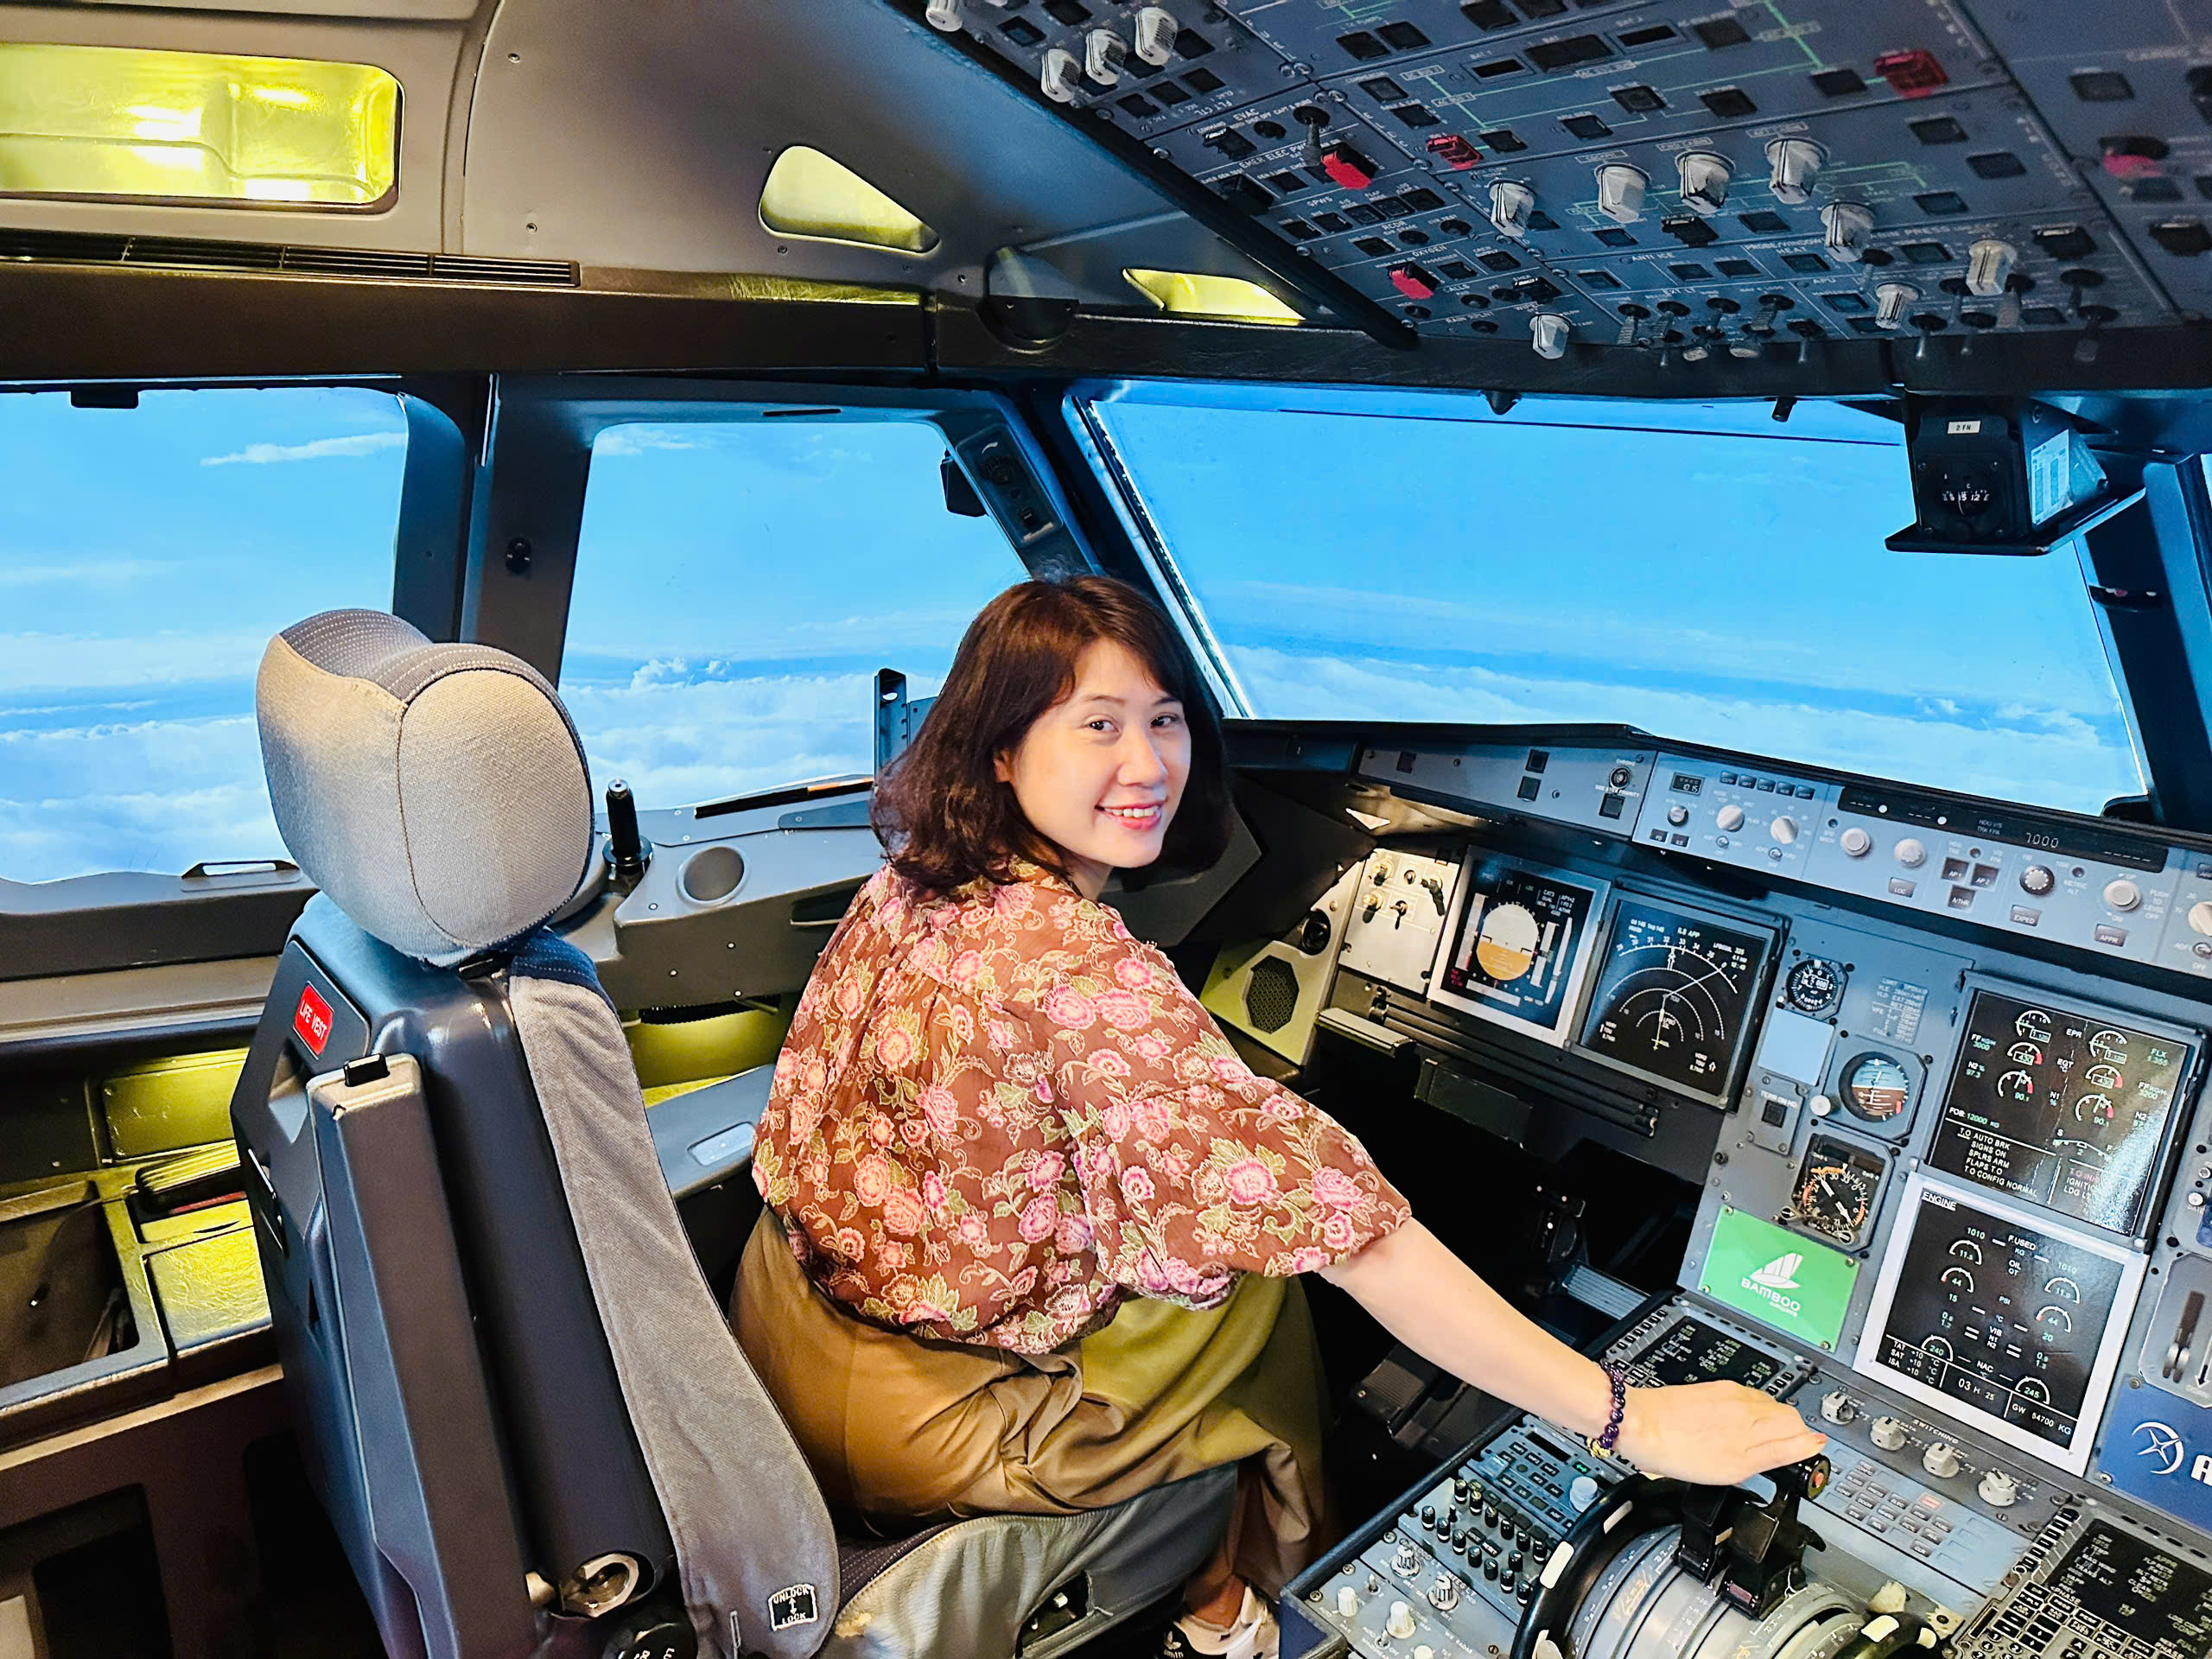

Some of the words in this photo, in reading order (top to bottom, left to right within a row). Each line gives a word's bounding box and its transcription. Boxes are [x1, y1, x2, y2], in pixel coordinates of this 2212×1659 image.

[1233, 108, 1259, 122] EVAC
[1239, 156, 1266, 168] EMER
[1267, 149, 1289, 162] ELEC
[1306, 196, 1333, 207] GPWS
[1412, 245, 1447, 257] OXYGEN
[1776, 246, 1808, 255] HEAT
[1989, 827, 2000, 836] FPA
[2025, 832, 2059, 849] 7000
[1894, 887, 1907, 895] LOC
[2150, 889, 2170, 899] PUSH
[1952, 897, 1970, 906] A/THR
[2013, 914, 2036, 925] EXPED
[1688, 929, 1700, 938] APP
[2100, 934, 2120, 944] APPR
[299, 999, 313, 1024] LIFE
[311, 1013, 327, 1040] VEST
[2066, 1028, 2082, 1038] EPR
[1973, 1041, 1990, 1051] 3000
[2151, 1047, 2168, 1058] FLX
[1967, 1061, 1978, 1070] N2
[2056, 1058, 2075, 1068] EGT
[2138, 1081, 2150, 1090] FF
[2014, 1092, 2030, 1102] 90.1
[2050, 1090, 2060, 1099] N1
[1967, 1112, 1988, 1125] 12000
[2135, 1111, 2147, 1121] N2
[2057, 1128, 2064, 1137] S
[1974, 1133, 1994, 1145] AUTO
[1994, 1140, 2011, 1150] BRK
[1971, 1141, 1993, 1154] SIGNS
[1994, 1148, 2006, 1159] ON
[1966, 1157, 1989, 1170] FLAPS
[1968, 1149, 1993, 1163] SPLRS
[1993, 1157, 2010, 1169] ARM
[1976, 1170, 2005, 1186] CONFIG
[2005, 1180, 2037, 1198] NORMAL
[2063, 1185, 2081, 1197] LDG
[1922, 1192, 1957, 1211] ENGINE
[1967, 1227, 1986, 1240] 1010
[2007, 1235, 2037, 1251] F.USED
[2014, 1247, 2025, 1256] KG
[2008, 1259, 2022, 1271] OIL
[2058, 1261, 2077, 1275] 1010
[1951, 1278, 1962, 1287] 44
[1741, 1276, 1801, 1313] BAMBOO
[1948, 1293, 1958, 1302] 15
[1999, 1295, 2011, 1306] PSI
[2047, 1316, 2058, 1326] 44
[1989, 1325, 2003, 1337] VIB
[2042, 1332, 2053, 1342] 20
[1893, 1340, 1906, 1351] TAT
[1929, 1344, 1944, 1357] 240
[1986, 1340, 1997, 1350] N2
[1891, 1348, 1904, 1359] SAT
[1888, 1357, 1900, 1369] ISA
[1976, 1360, 1994, 1373] NAC
[1958, 1377, 1972, 1392] 03
[1974, 1385, 1981, 1395] H
[1985, 1391, 1995, 1401] 25
[2024, 1387, 2040, 1399] 245
[2012, 1403, 2026, 1414] GW
[2057, 1424, 2072, 1435] KG
[1911, 1418, 1960, 1445] SWITCHING
[1914, 1546, 1926, 1554] CLR
[2091, 1544, 2109, 1555] TEMP
[2082, 1554, 2098, 1565] MAG
[2075, 1563, 2097, 1579] TRANS
[2099, 1576, 2113, 1586] ALT
[2127, 1578, 2152, 1593] CLEAN
[773, 1585, 810, 1605] UNLOCK
[781, 1611, 808, 1625] LOCK
